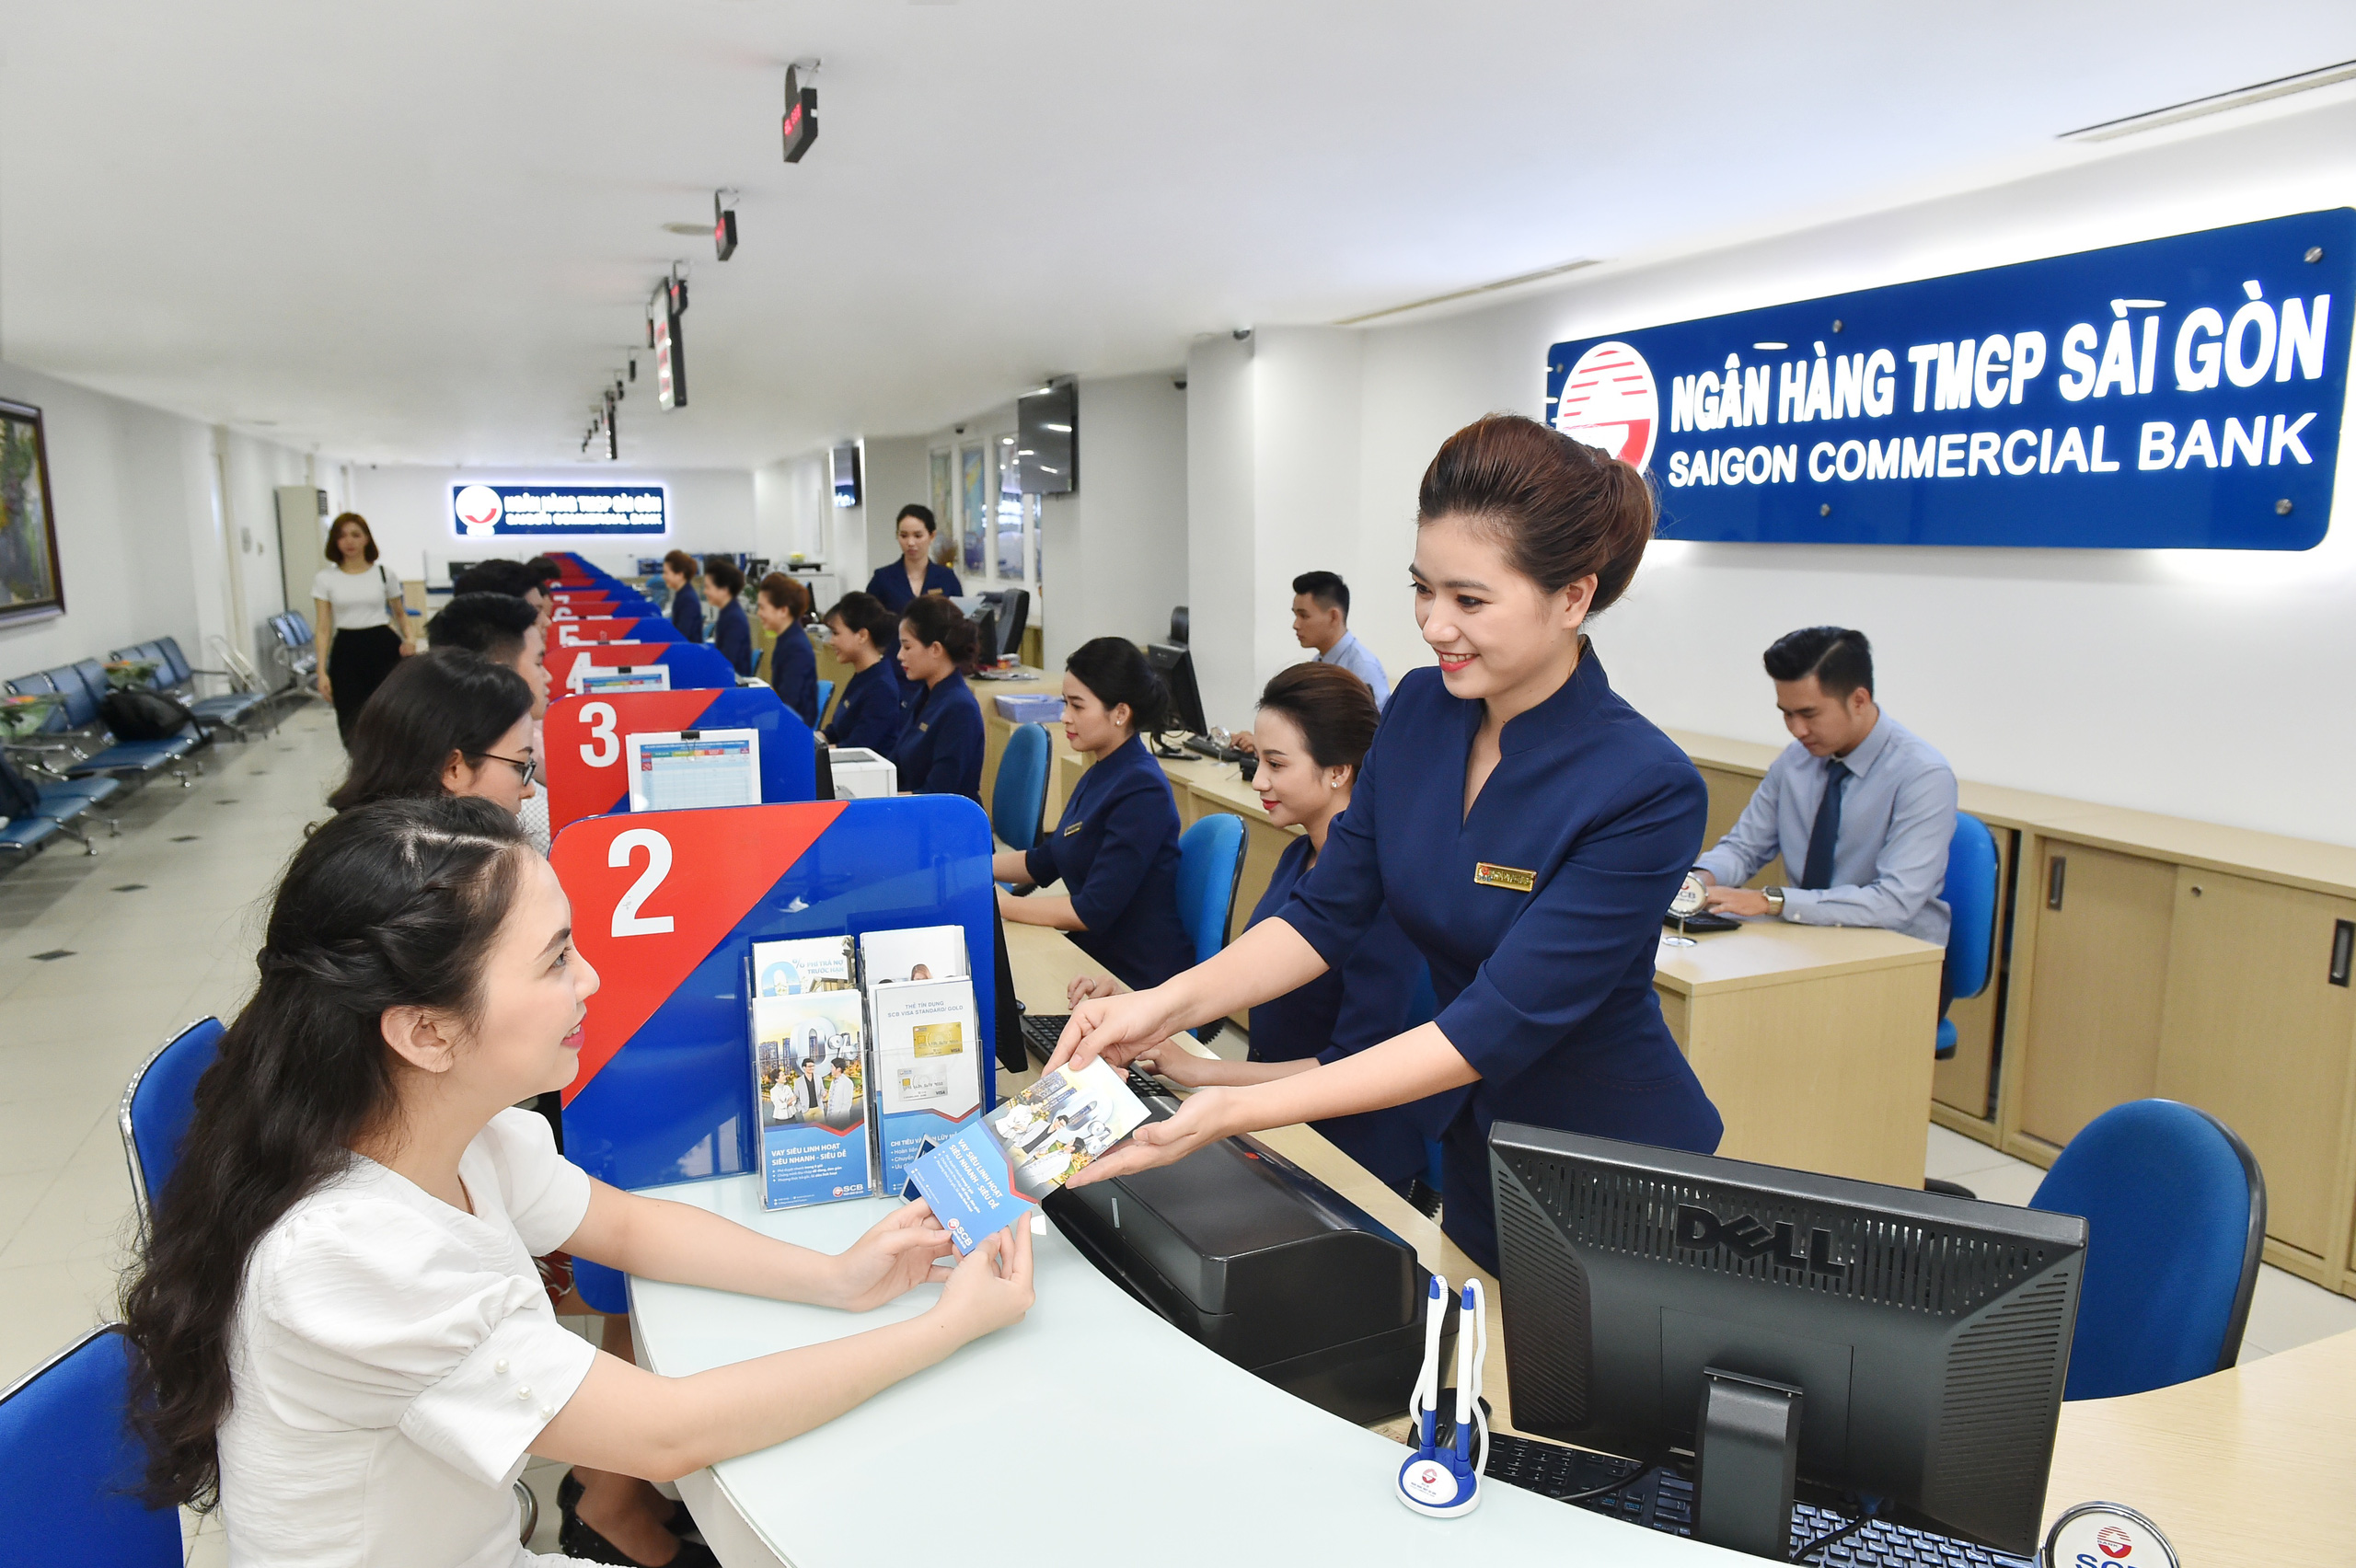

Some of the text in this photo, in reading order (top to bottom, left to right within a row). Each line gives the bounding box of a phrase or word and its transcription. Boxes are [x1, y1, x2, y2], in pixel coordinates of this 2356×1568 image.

[1670, 352, 1771, 432] NGÂN
[1777, 340, 1896, 424] HÀNG
[2059, 298, 2160, 402] SÀI
[2174, 280, 2331, 391] GÒN
[1668, 412, 2318, 488] SAIGON COMMERCIAL BANK
[559, 625, 580, 646] 5
[565, 651, 592, 689] 4
[578, 701, 620, 768] 3
[607, 828, 675, 938] 2
[1679, 891, 1696, 899] CB
[771, 1158, 788, 1166] SIÊU
[789, 1155, 815, 1163] NHANH
[820, 1151, 836, 1160] SIÊU
[786, 1147, 803, 1156] SIÊU
[803, 1145, 820, 1153] LINH
[821, 1142, 841, 1151] HOẠT
[958, 1138, 970, 1153] VAY
[965, 1149, 980, 1167] SIÊU
[976, 1164, 991, 1183] LINH
[843, 1183, 863, 1193] SCB
[949, 1144, 962, 1161] SIÊU
[959, 1159, 979, 1183] NHANH
[977, 1184, 991, 1203] SIÊU
[956, 1226, 974, 1247] SCB
[1675, 1203, 1846, 1278] DELL
